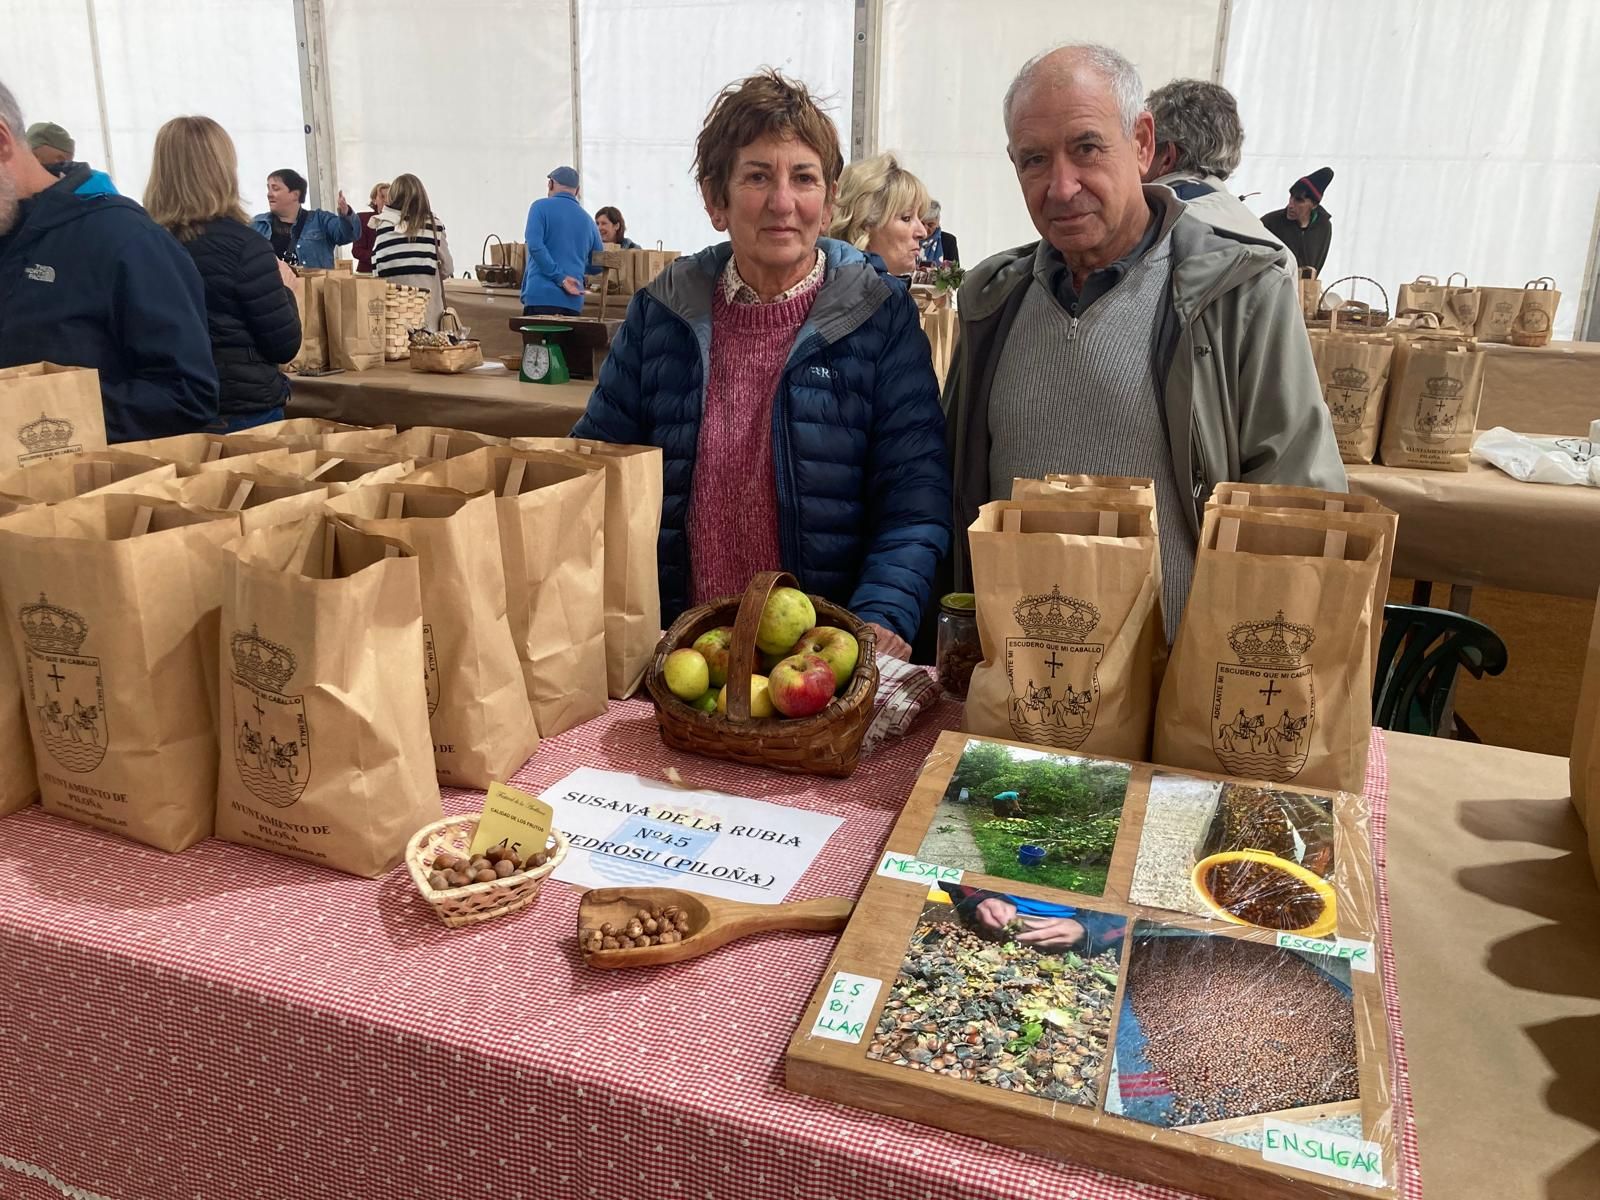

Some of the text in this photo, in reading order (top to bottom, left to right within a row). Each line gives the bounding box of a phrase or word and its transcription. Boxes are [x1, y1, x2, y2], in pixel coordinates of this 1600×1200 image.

[1007, 650, 1014, 658] MI
[1009, 641, 1045, 649] ESCUDERO
[1046, 643, 1060, 651] QUE
[67, 658, 98, 667] CABALLO
[428, 651, 436, 672] HALLA
[1220, 666, 1261, 677] ESCUDERO
[1263, 671, 1279, 679] QUE
[268, 695, 301, 705] CABALLO
[1214, 675, 1225, 720] ADELANTE MI
[298, 724, 307, 748] HALLA
[439, 744, 455, 753] DE
[43, 772, 128, 803] AYUNTAMIENTO DE
[68, 793, 104, 810] PILOÑA
[231, 800, 330, 835] AYUNTAMIENTO DE
[490, 808, 511, 819] CALIDAD
[526, 821, 545, 833] FRUTOS
[562, 791, 803, 848] SUSANA DE LA RUBIA
[258, 824, 298, 843] PILOÑA
[560, 831, 776, 888] PEDROSU (PILOÑA)
[884, 857, 960, 881] MESAR
[1280, 935, 1367, 962] ESCOYER
[833, 979, 865, 996] ES
[818, 1016, 865, 1039] LLAR
[1266, 1129, 1380, 1175] ENSUGAR
